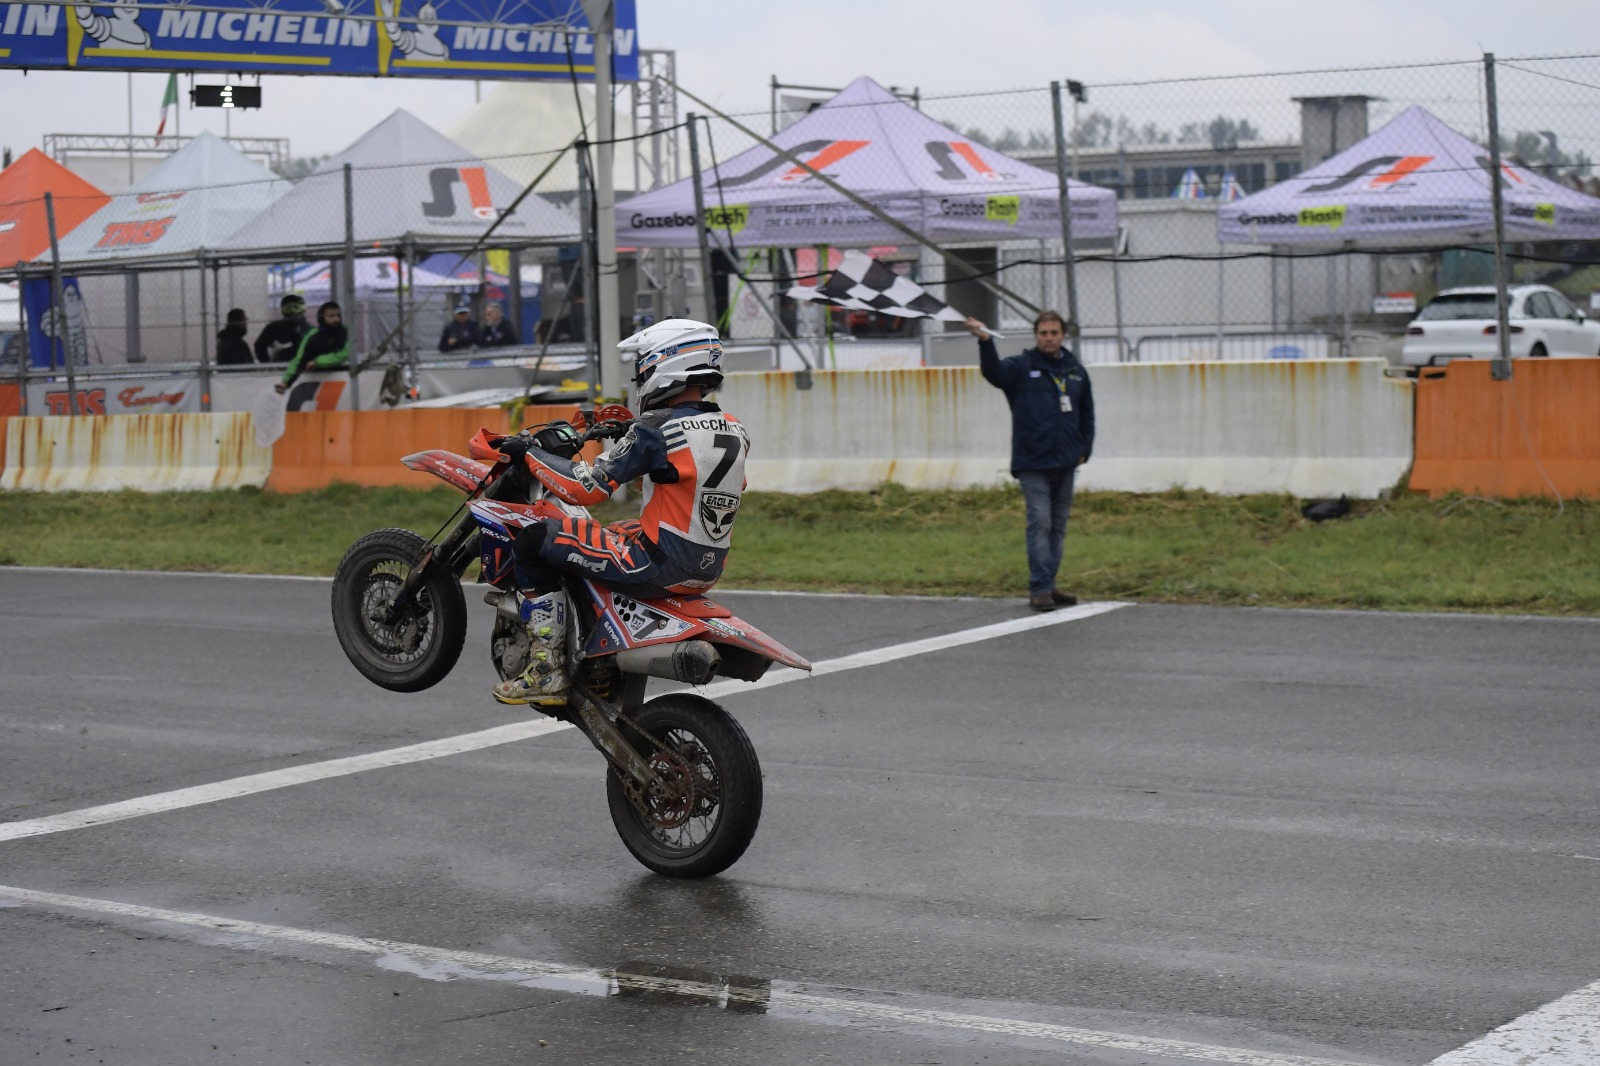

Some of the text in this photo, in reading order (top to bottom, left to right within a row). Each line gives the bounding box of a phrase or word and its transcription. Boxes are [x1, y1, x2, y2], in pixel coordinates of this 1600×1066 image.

[156, 9, 373, 47] MICHELIN
[453, 24, 635, 57] MICHELN
[630, 212, 697, 229] Gazebo
[702, 433, 742, 489] 7
